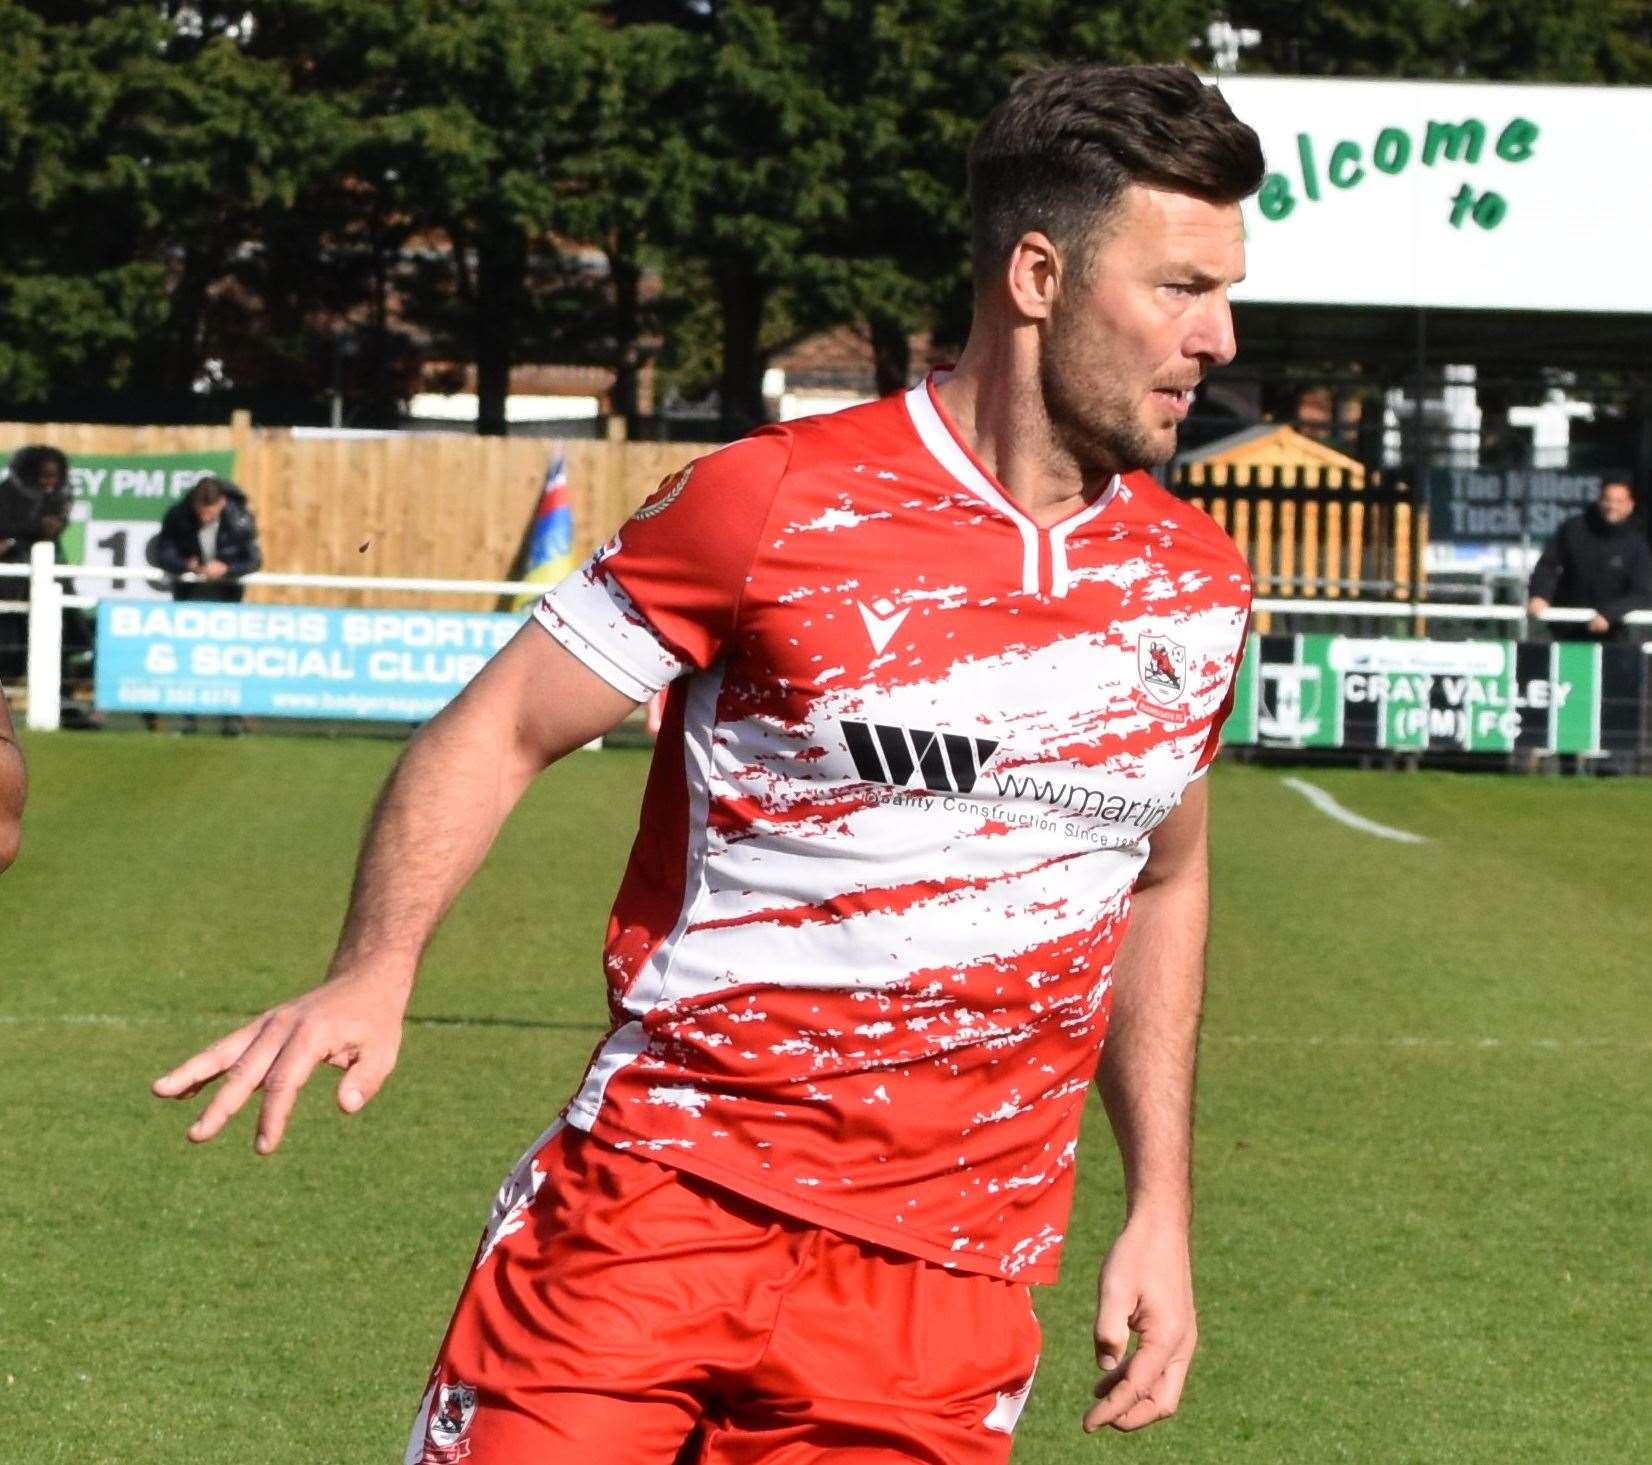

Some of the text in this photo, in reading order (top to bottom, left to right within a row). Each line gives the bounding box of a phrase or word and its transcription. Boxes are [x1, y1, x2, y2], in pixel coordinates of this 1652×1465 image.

[1256, 117, 1541, 222] elcome
[1449, 183, 1508, 230] to
[112, 468, 164, 497] PM
[1451, 502, 1522, 534] Tuck
[110, 605, 328, 643] BADGERS
[144, 642, 488, 685] & SOCIAL CLUB
[1345, 674, 1573, 709] CRAY VALLEY
[1394, 708, 1523, 742] (PM) FC
[942, 796, 1058, 833] Construction
[1064, 822, 1108, 847] Since
